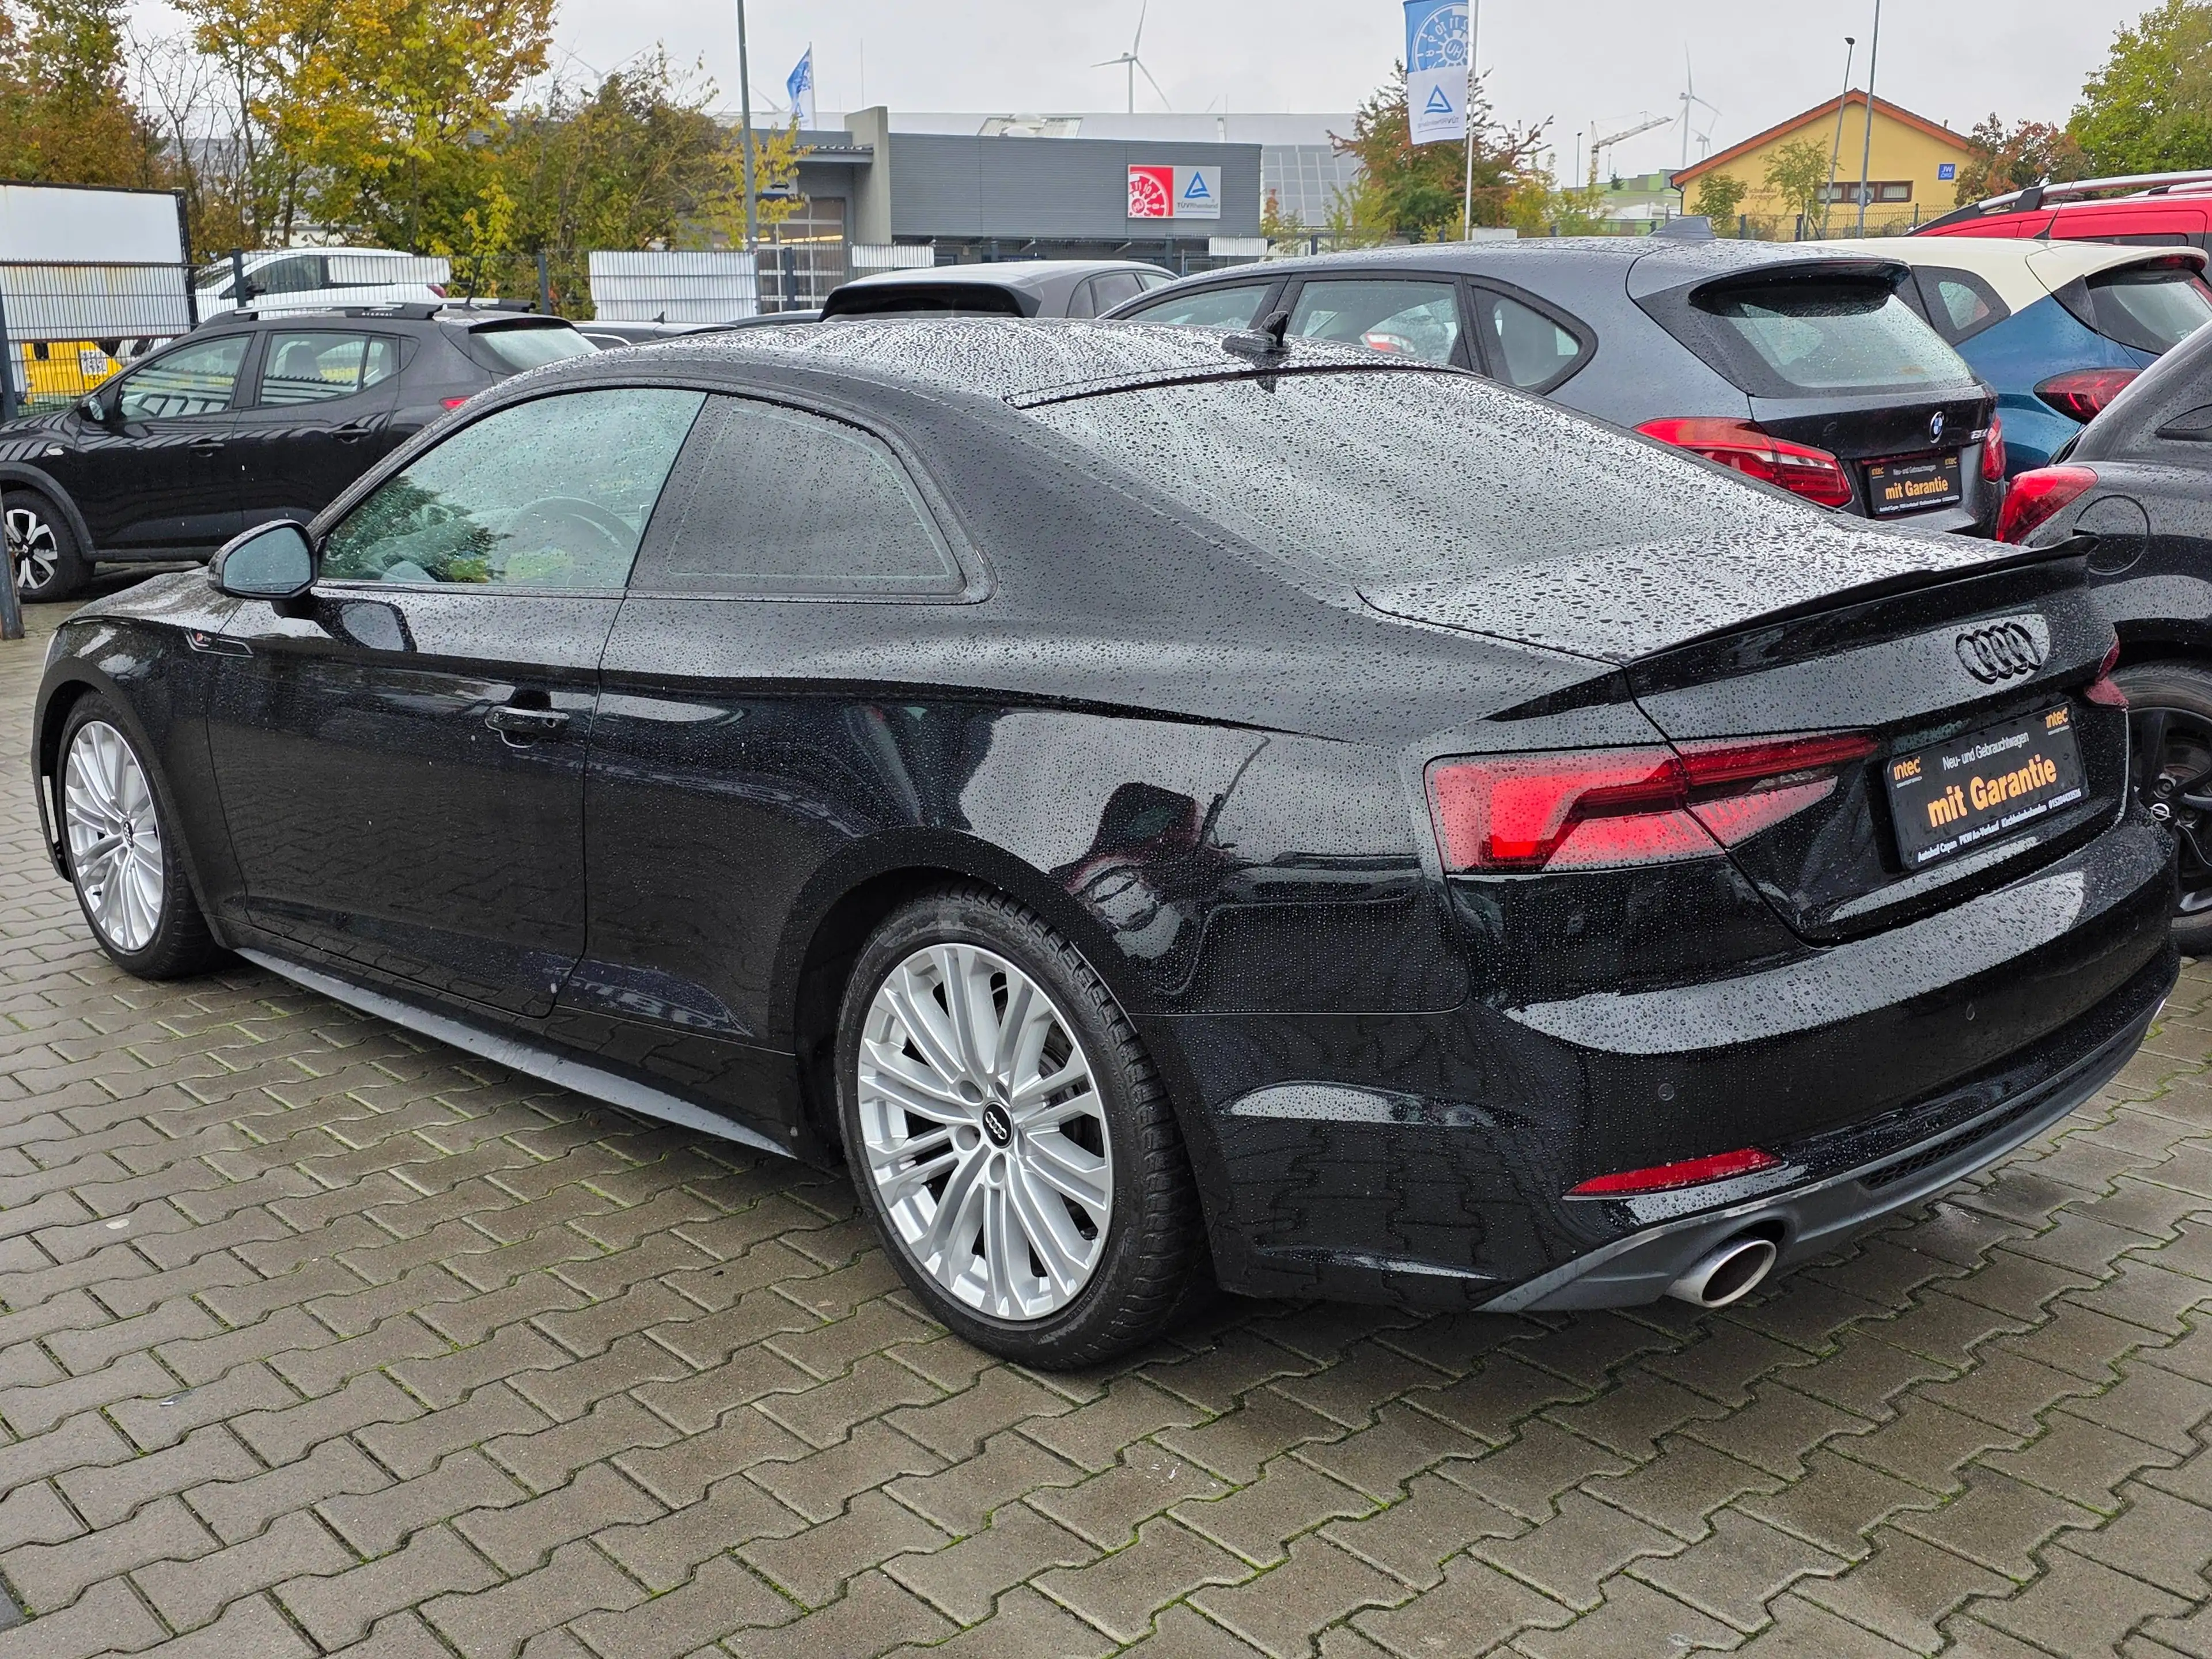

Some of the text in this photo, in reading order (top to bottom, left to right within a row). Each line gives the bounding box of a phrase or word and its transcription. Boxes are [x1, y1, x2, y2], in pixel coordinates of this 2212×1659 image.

[1885, 476, 1948, 500] mit Garantie
[1942, 732, 2029, 771] Neu- und Gebrauchtwagen
[1927, 753, 2057, 828] mit Garantie
